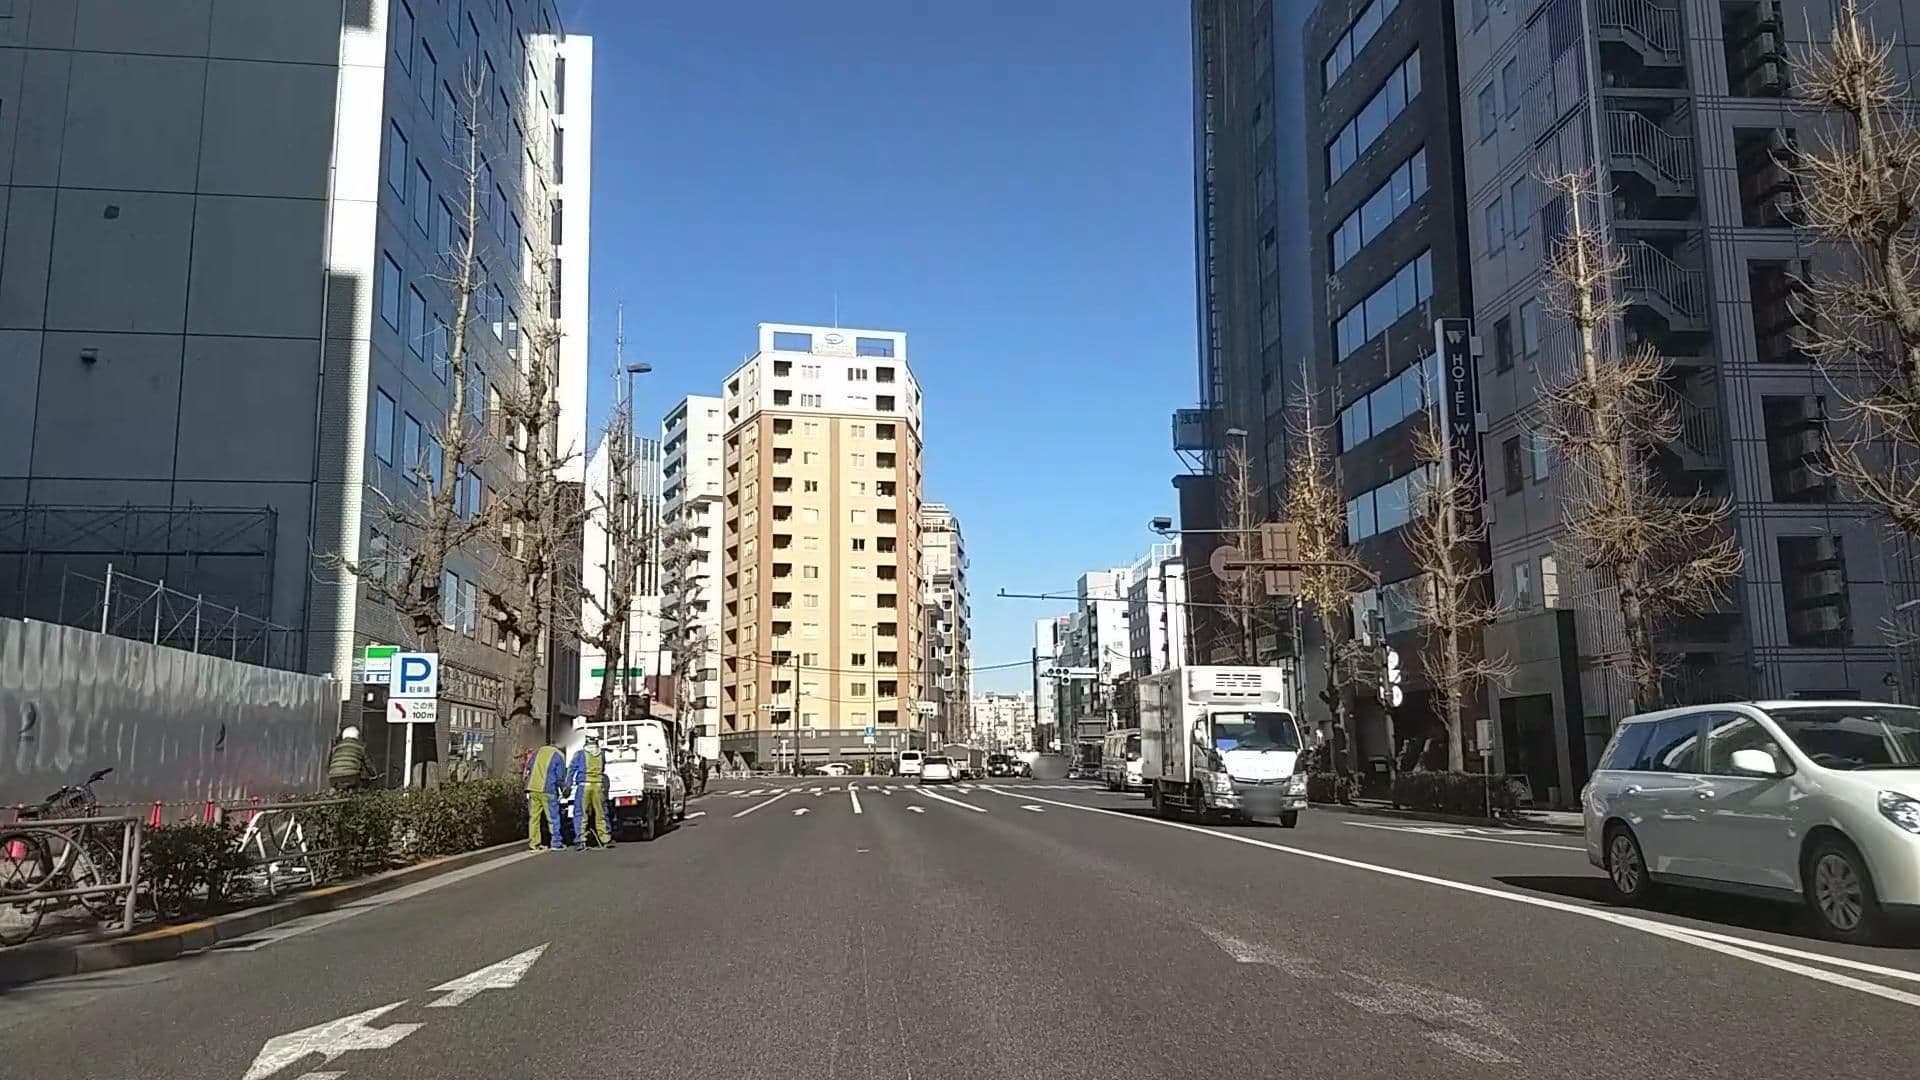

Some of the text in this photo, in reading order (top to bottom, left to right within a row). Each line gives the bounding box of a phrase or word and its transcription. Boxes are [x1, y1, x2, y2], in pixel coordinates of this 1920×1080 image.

[1452, 354, 1473, 476] HOTEL WING
[401, 658, 431, 693] P
[412, 711, 434, 719] 100m
